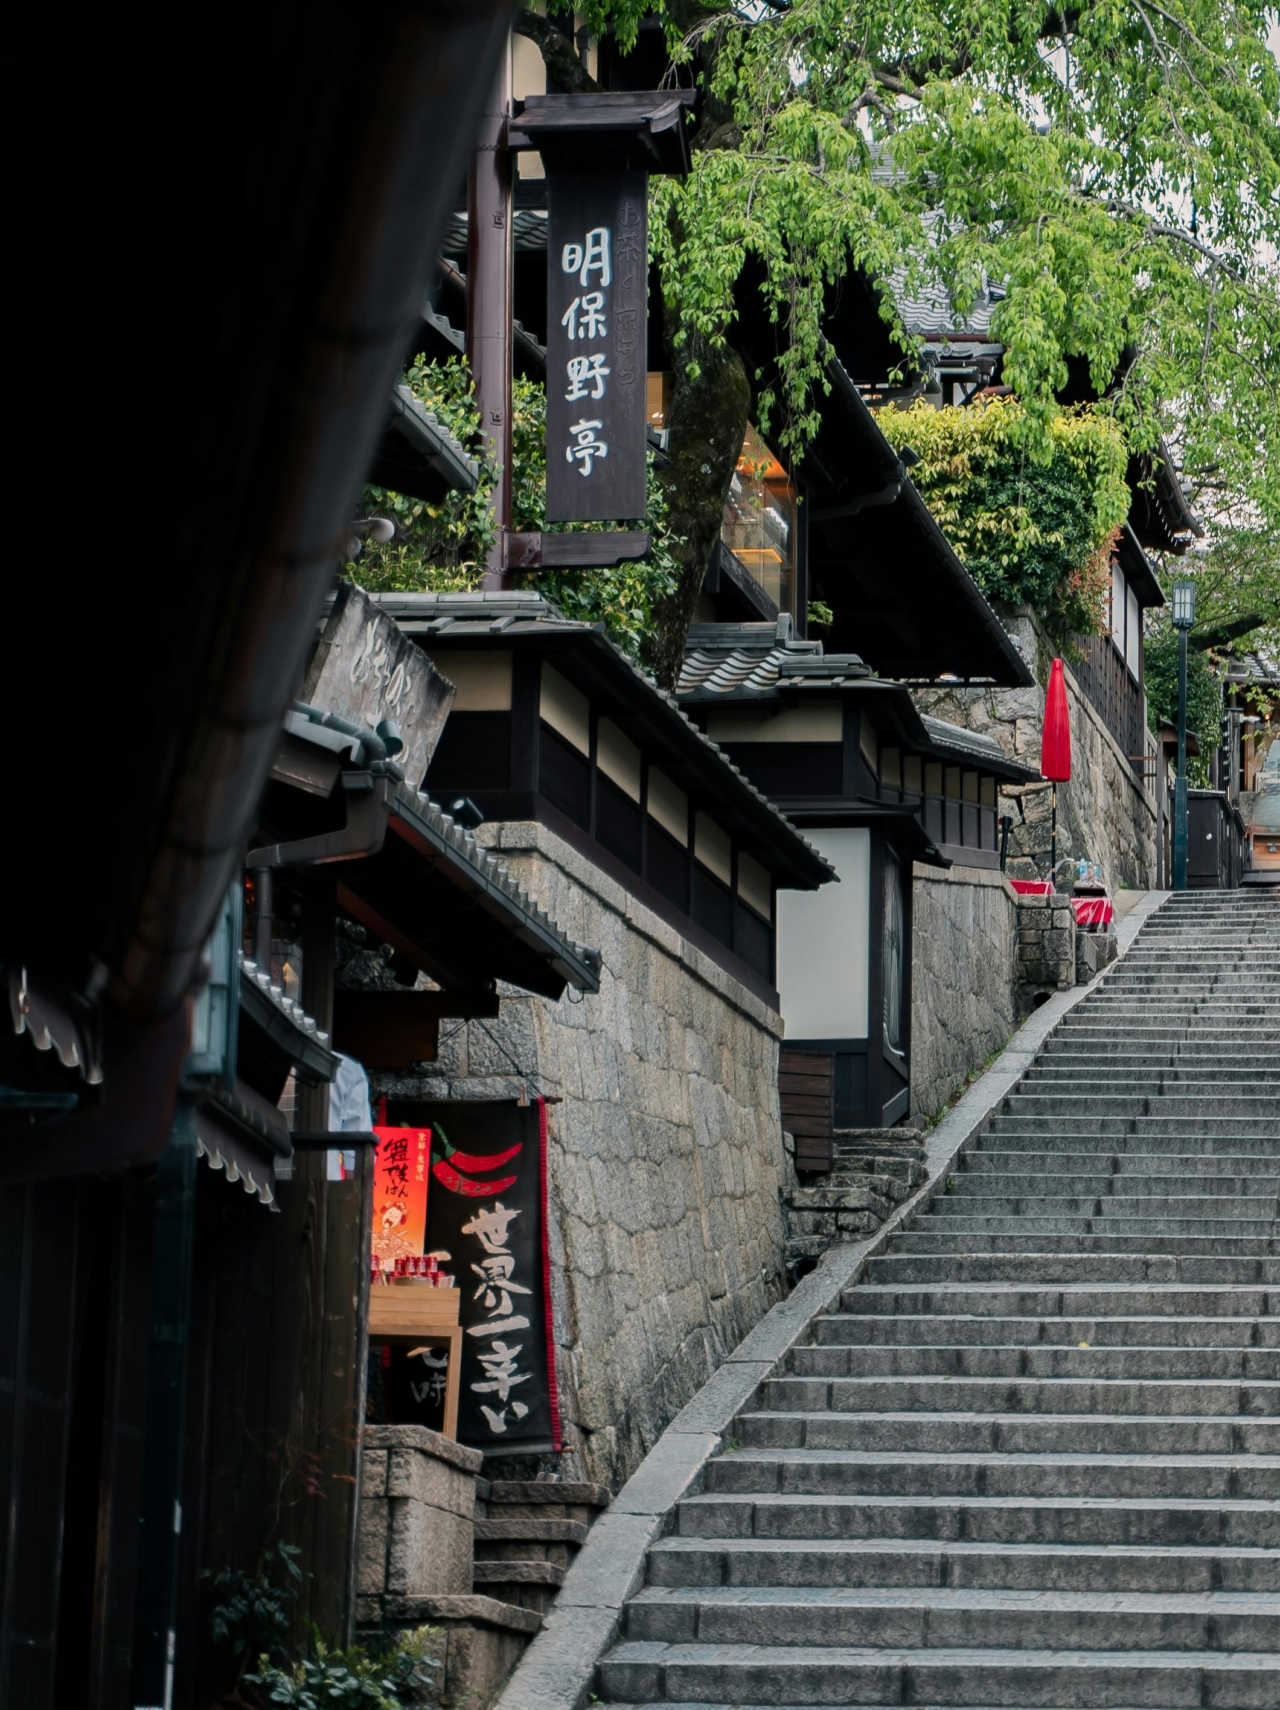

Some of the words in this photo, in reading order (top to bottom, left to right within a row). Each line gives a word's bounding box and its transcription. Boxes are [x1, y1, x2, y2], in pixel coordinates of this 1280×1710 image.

[562, 226, 611, 478] 明保野亭
[382, 1136, 411, 1199] 舞妓はん
[461, 1201, 534, 1434] 世界一辛い
